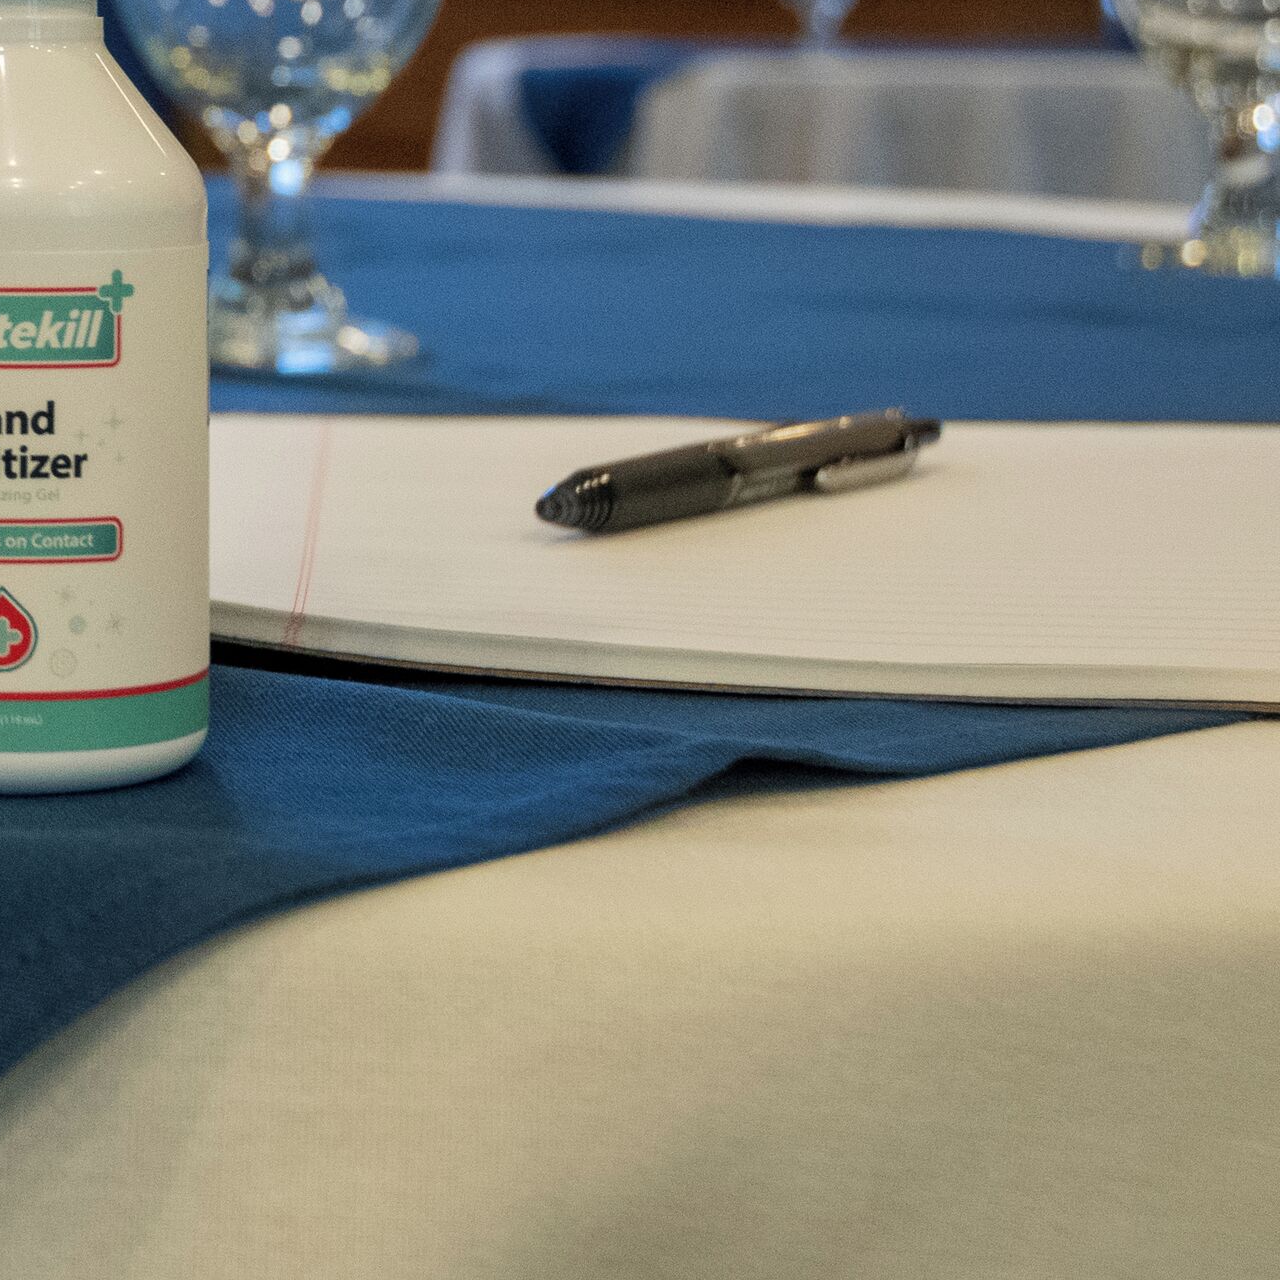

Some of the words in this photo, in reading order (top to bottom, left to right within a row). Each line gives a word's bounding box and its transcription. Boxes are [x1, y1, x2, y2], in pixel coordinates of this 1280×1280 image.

[36, 487, 61, 501] Gel
[4, 534, 28, 548] on
[31, 533, 95, 548] Contact
